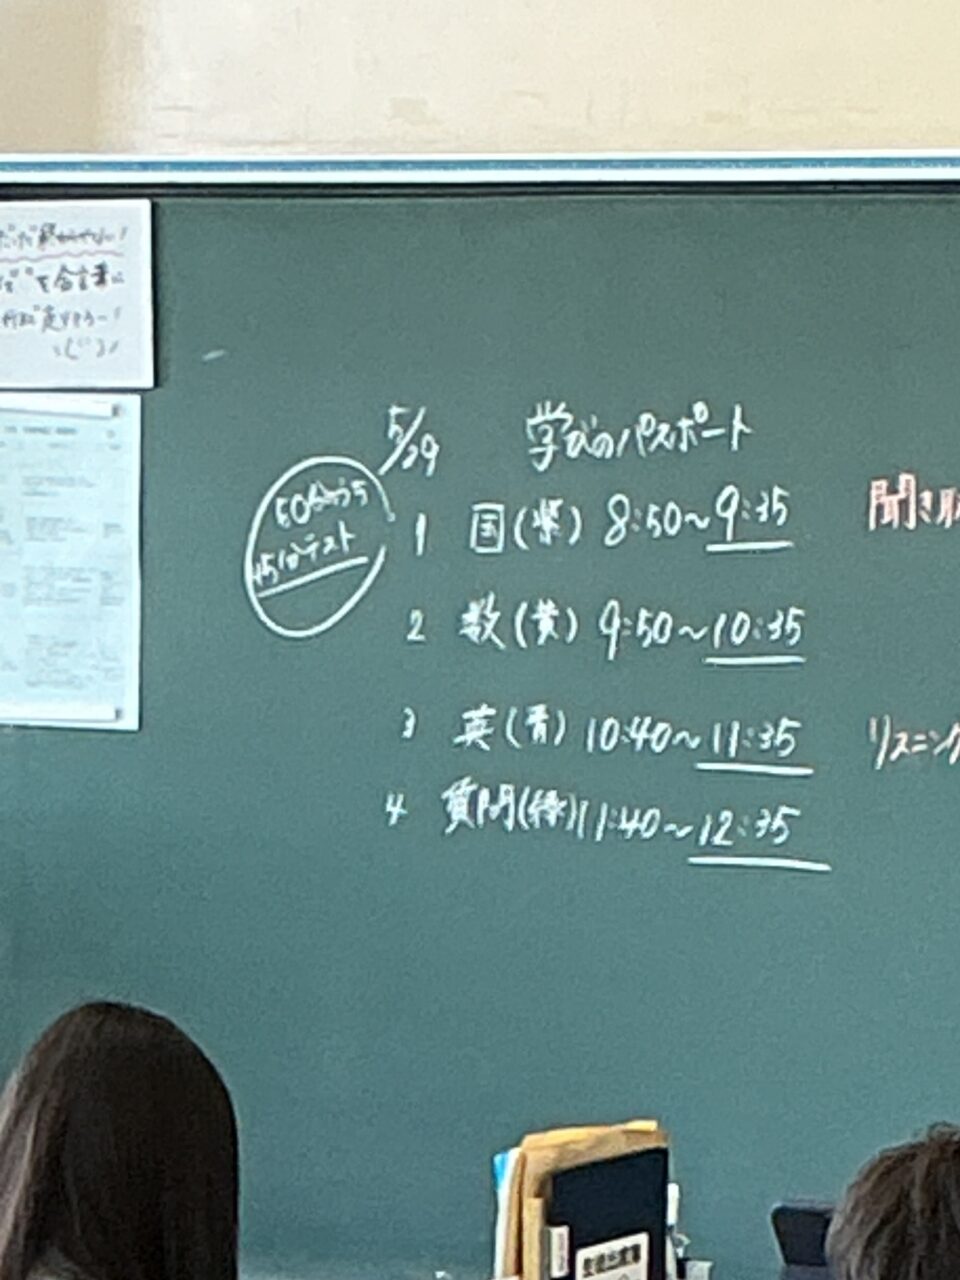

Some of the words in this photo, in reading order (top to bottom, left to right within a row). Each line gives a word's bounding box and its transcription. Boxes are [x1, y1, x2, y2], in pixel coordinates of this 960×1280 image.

[526, 400, 753, 473] 学びのパスポート
[416, 512, 427, 557] 1
[407, 609, 426, 642] 2
[385, 793, 408, 827] 4
